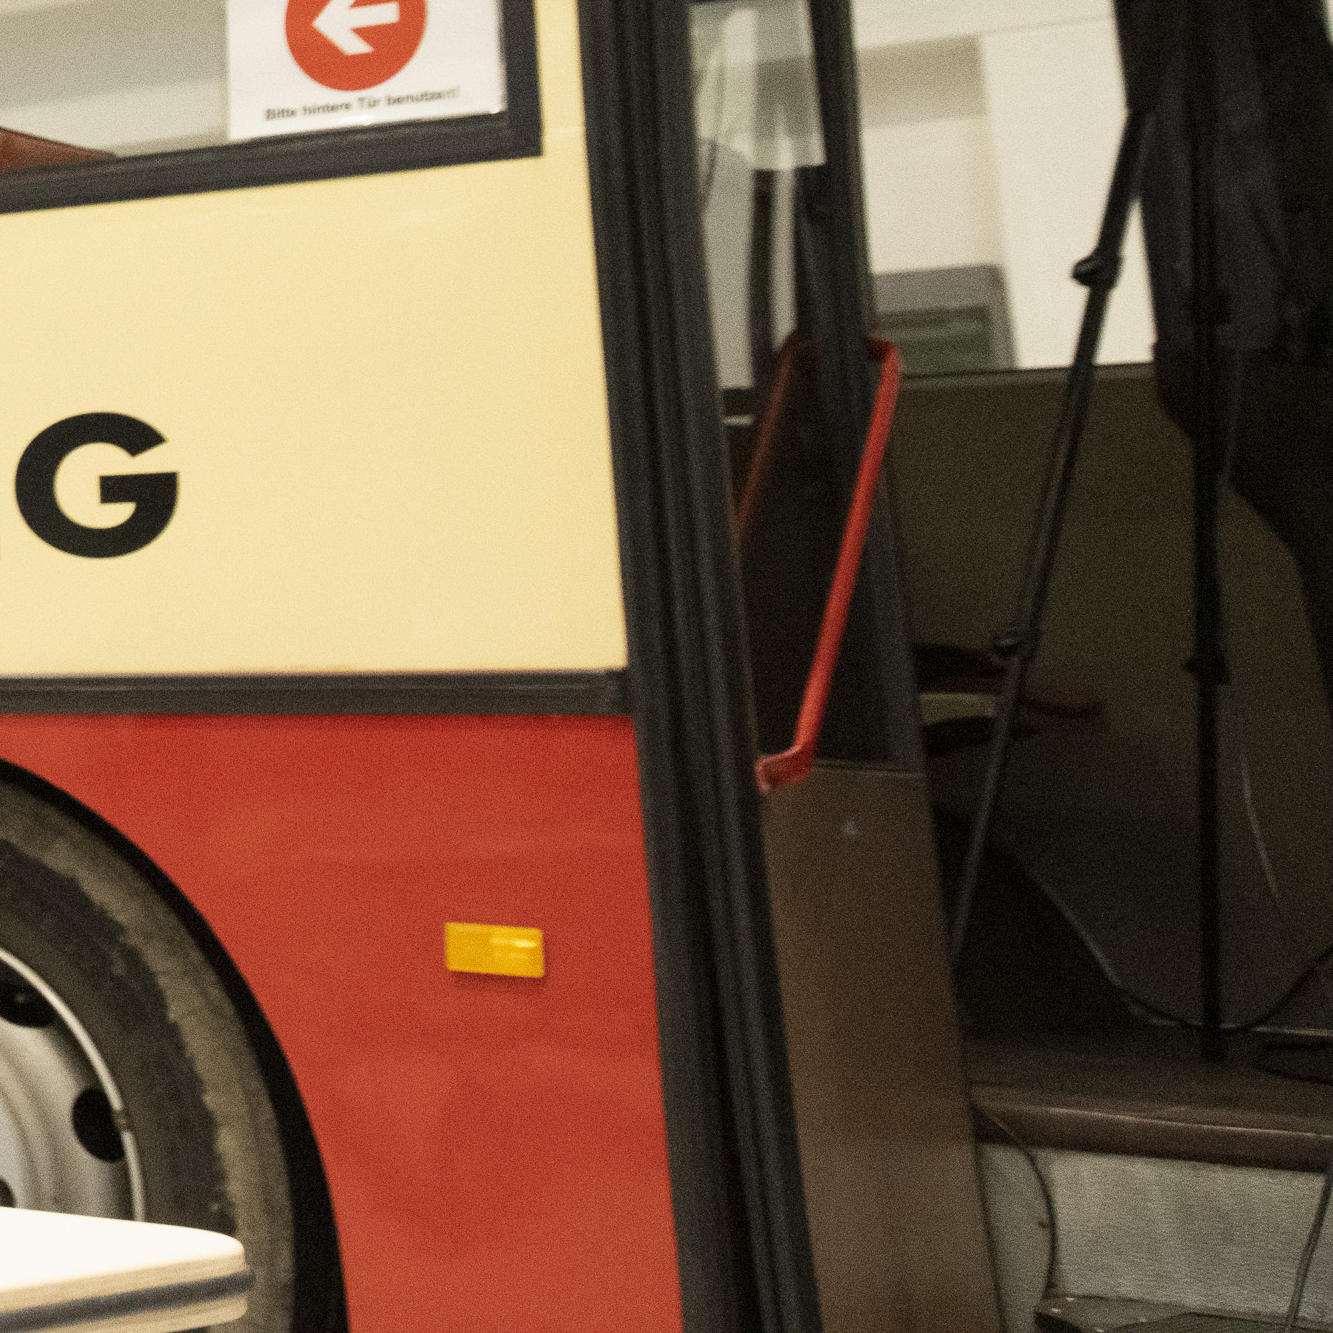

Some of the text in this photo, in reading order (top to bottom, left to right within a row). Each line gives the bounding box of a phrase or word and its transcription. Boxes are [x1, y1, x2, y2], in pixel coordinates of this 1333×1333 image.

[264, 105, 298, 122] Bitte
[303, 100, 352, 116] hintere
[357, 96, 382, 110] Tür
